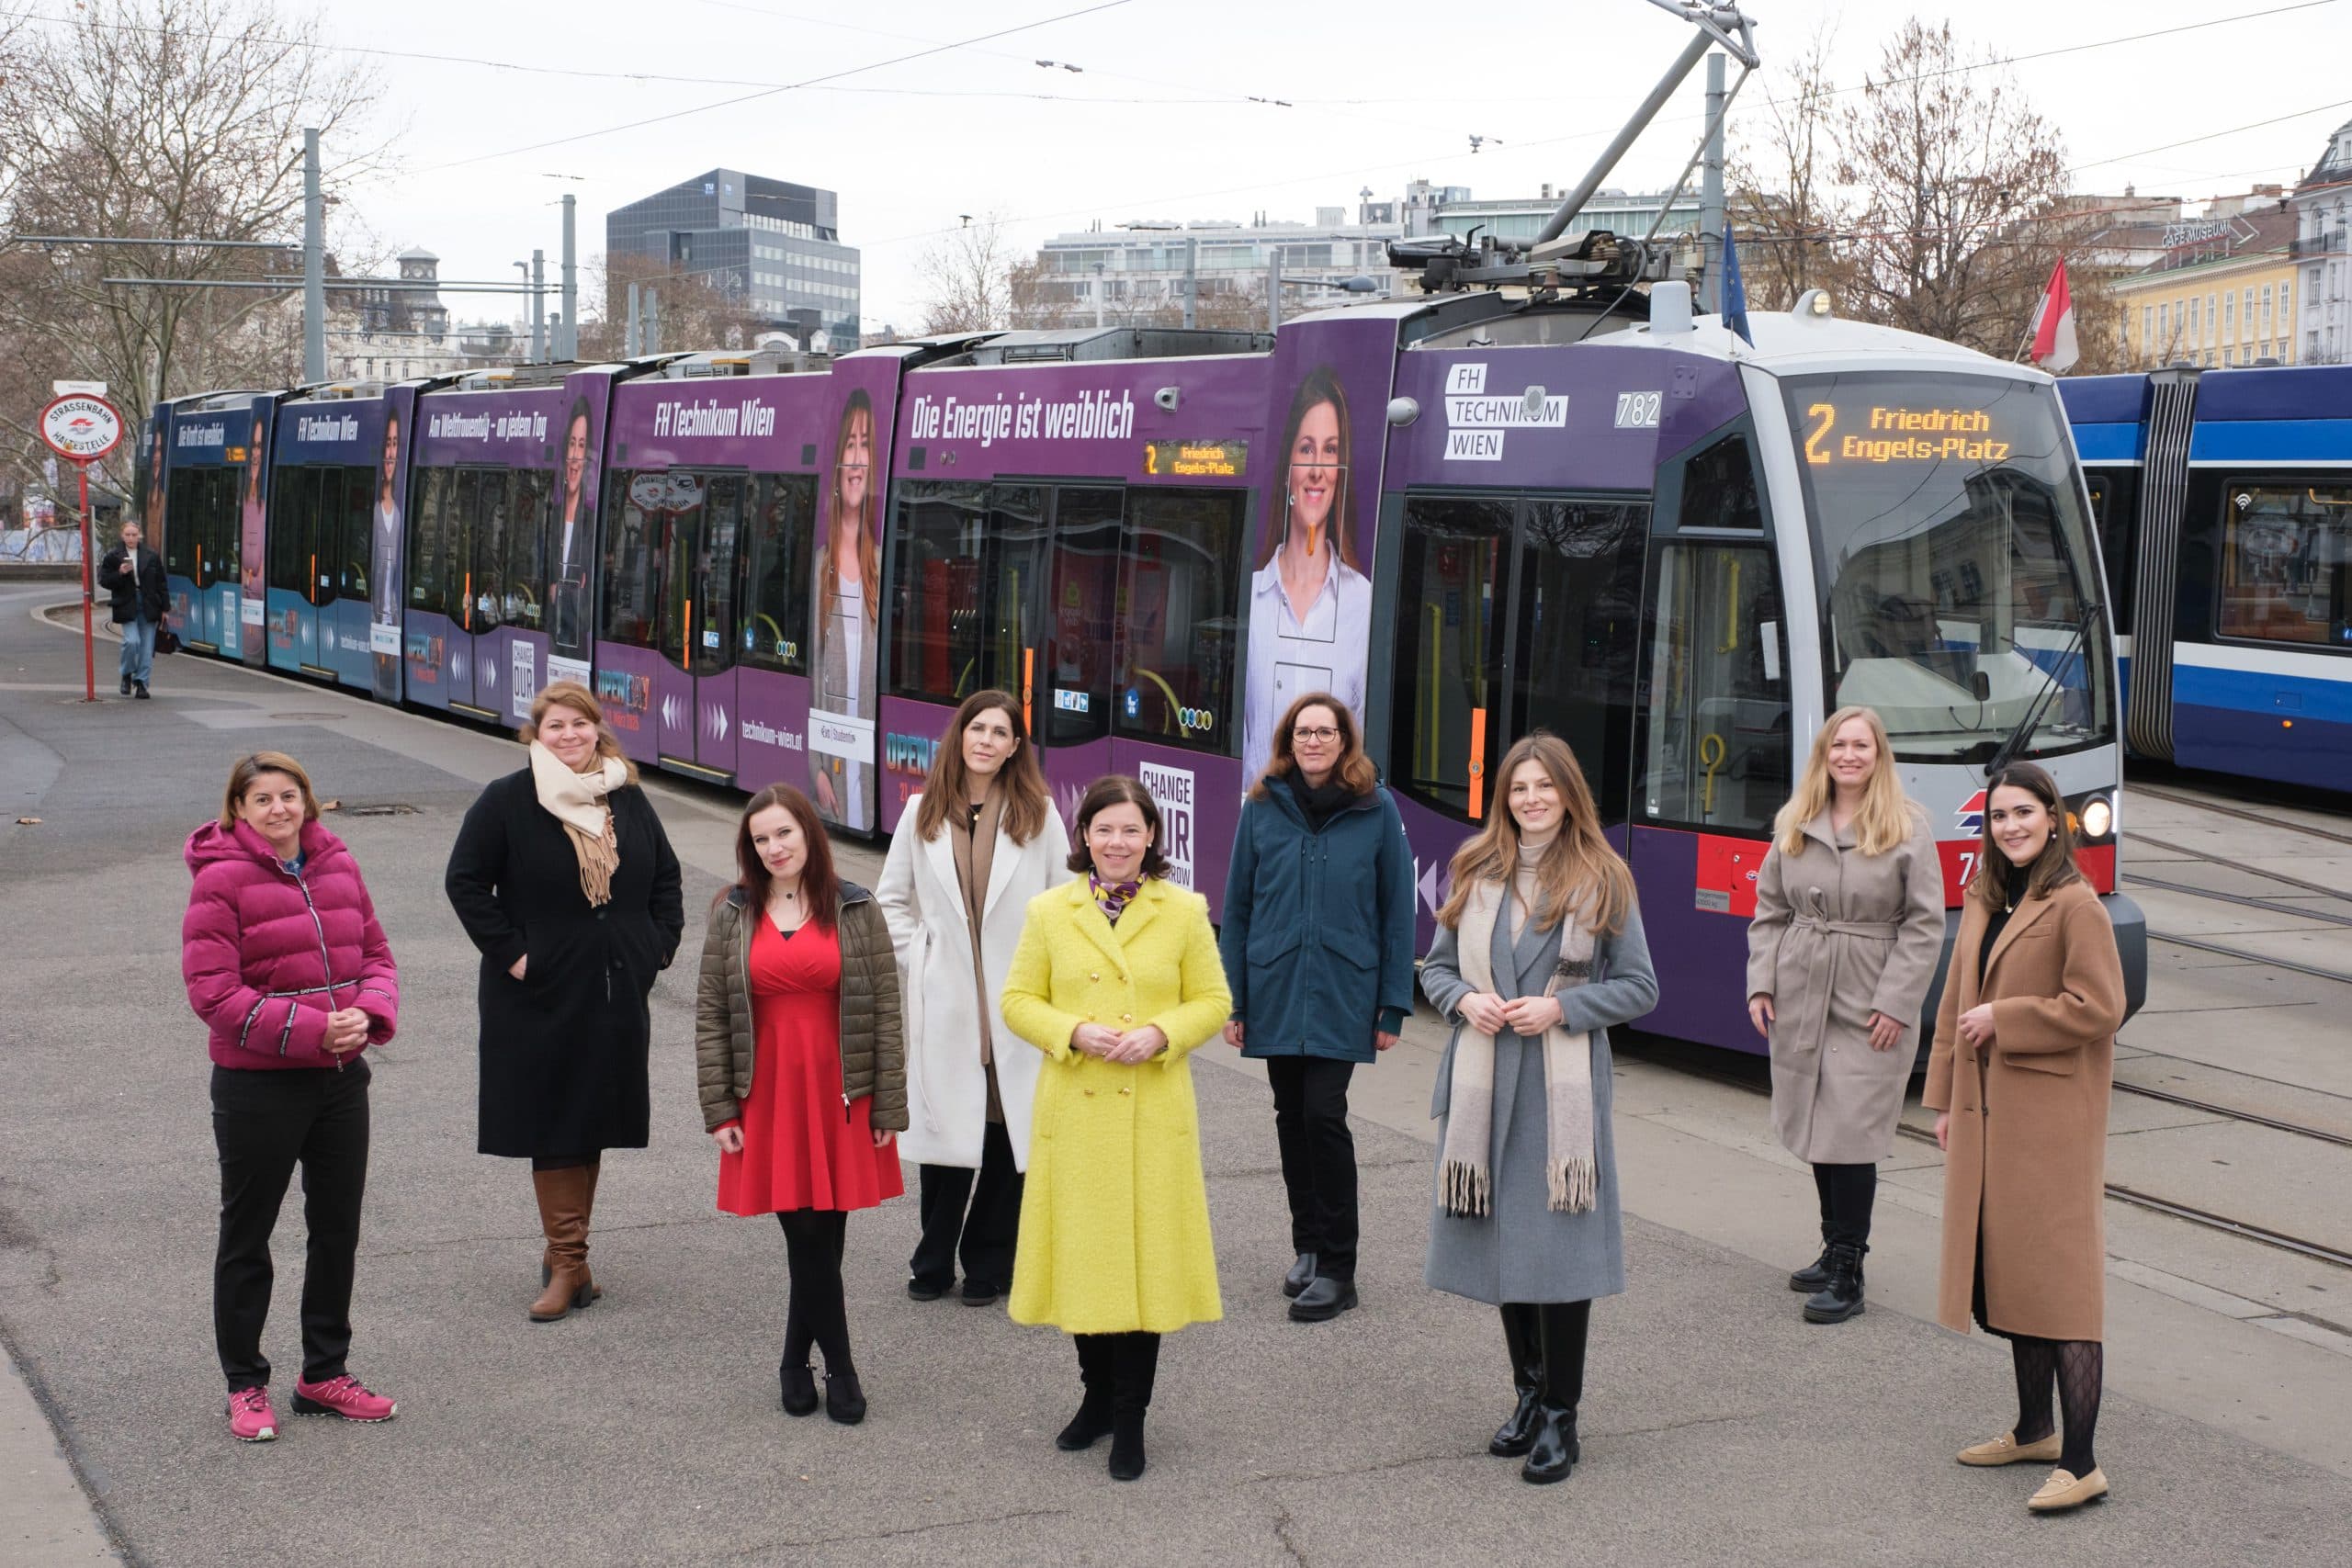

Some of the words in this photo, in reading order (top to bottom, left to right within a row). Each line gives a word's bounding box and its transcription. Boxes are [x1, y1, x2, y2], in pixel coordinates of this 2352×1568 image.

[1458, 369, 1481, 389] FH
[50, 401, 114, 424] STRASSENBAHN
[654, 402, 672, 436] FH
[673, 399, 739, 436] Technikum
[741, 397, 775, 436] Wien
[911, 395, 941, 439] Die
[942, 392, 1012, 448] Energie
[1014, 391, 1042, 439] ist
[1045, 389, 1135, 439] weiblich
[1616, 392, 1661, 427] 782
[1871, 407, 1990, 432] Friedrich
[506, 410, 532, 442] jedem
[532, 411, 548, 443] Tag
[1805, 404, 1836, 463] 2
[1147, 445, 1158, 474] 2
[1182, 446, 1225, 459] Friedrich
[1453, 435, 1498, 456] WIEN
[1843, 435, 2009, 462] Engels-Platz
[1174, 461, 1235, 475] Engels-Platz
[514, 666, 533, 699] OUR
[887, 732, 929, 776] OPEN
[1143, 770, 1192, 806] CHANGE
[1159, 806, 1191, 863] UR
